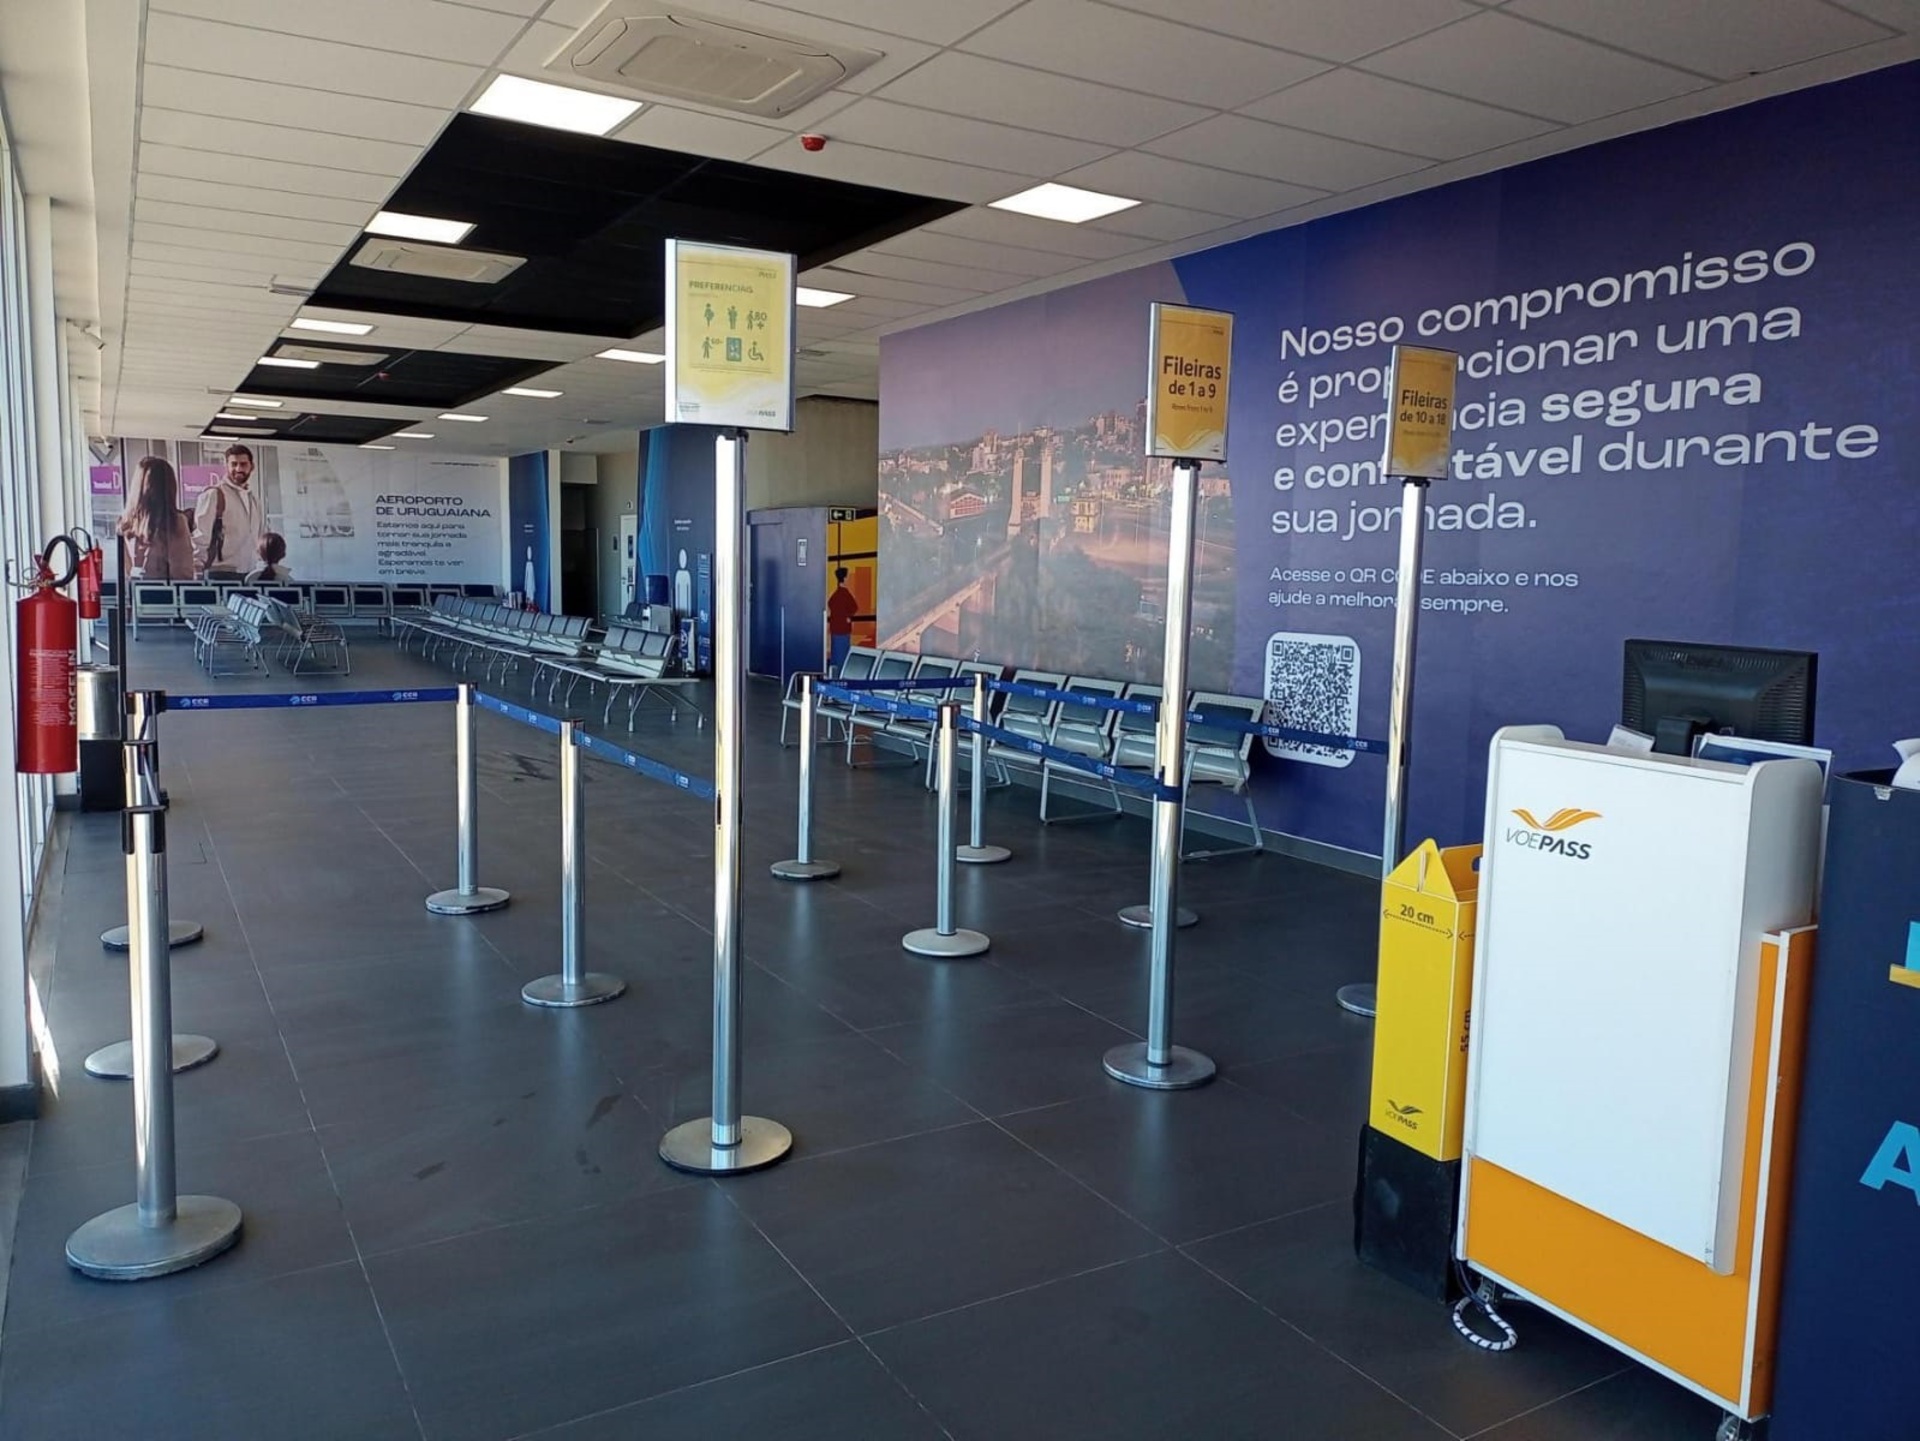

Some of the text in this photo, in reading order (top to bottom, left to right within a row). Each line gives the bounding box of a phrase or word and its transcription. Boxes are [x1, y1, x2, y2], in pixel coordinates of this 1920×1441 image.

[1281, 242, 1816, 361] Nosso compromisso
[1163, 356, 1222, 380] Fileiras
[1278, 306, 1802, 409] é procionar uma
[1168, 380, 1216, 398] de 1 a 9
[1402, 389, 1448, 409] Fileiras
[1276, 372, 1762, 452] expercia segura
[1401, 411, 1446, 425] de 10 a 18
[1273, 468, 1295, 491] e
[1598, 421, 1879, 473] durante
[376, 495, 464, 506] AEROPORTO
[376, 506, 490, 518] DE URUGUAIANA
[1271, 508, 1338, 534] sua
[1270, 567, 1579, 588] Acesse o QR CE abaixo e nos
[1268, 589, 1509, 615] ajude a melhor sempre.
[1505, 828, 1592, 860] VOEPASS
[1400, 903, 1435, 925] 20 cm
